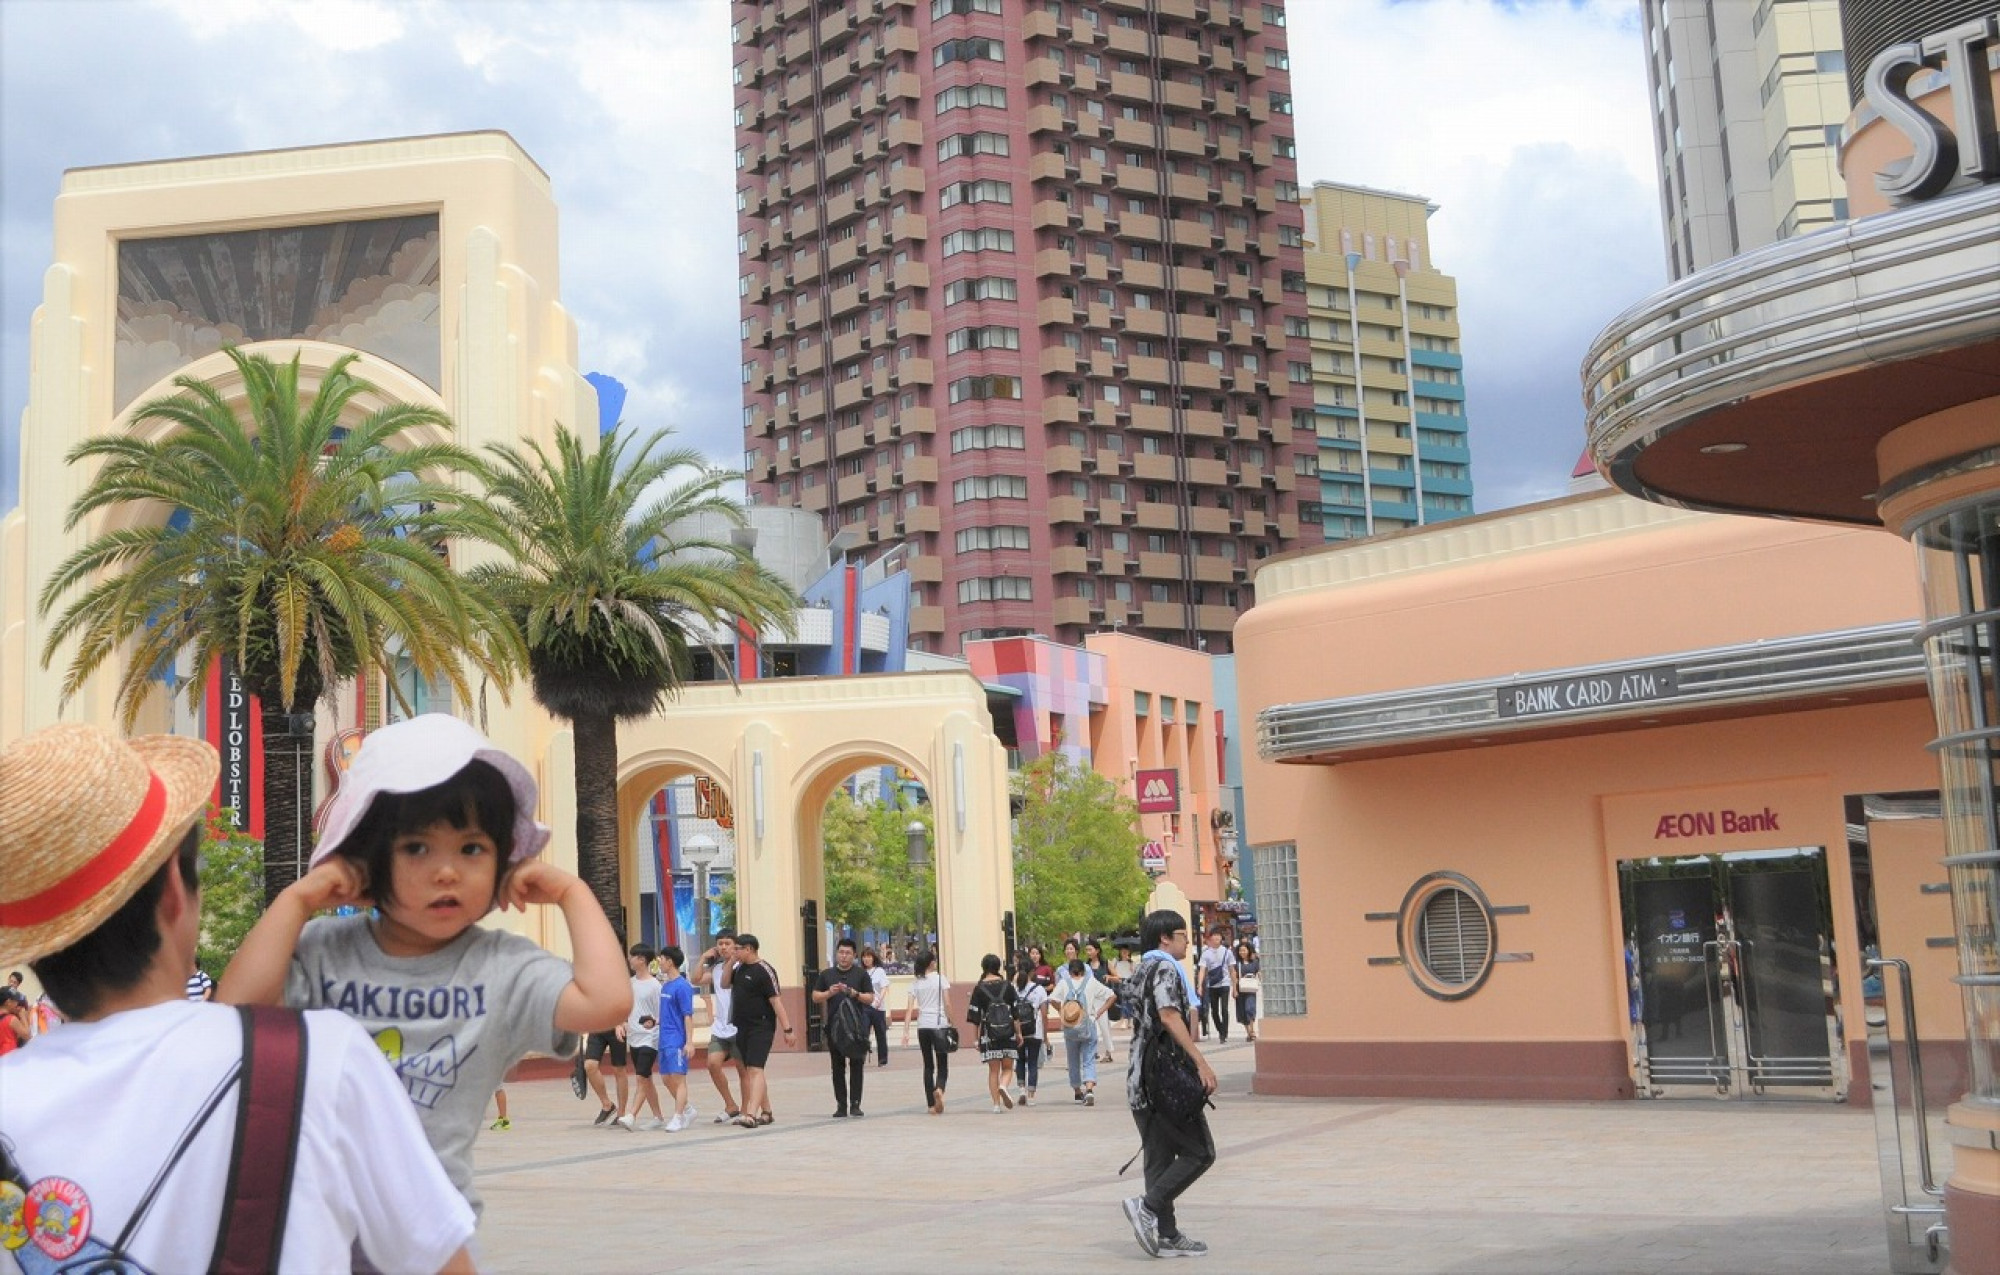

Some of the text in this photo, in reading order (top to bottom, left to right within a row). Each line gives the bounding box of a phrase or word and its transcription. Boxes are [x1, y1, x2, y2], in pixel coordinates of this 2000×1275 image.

[1864, 14, 2000, 204] ST
[1515, 674, 1656, 713] BANK CARD ATM
[228, 658, 243, 826] ED LOBSTER
[1720, 807, 1780, 834] Bank
[321, 974, 487, 1020] KAKIGORI
